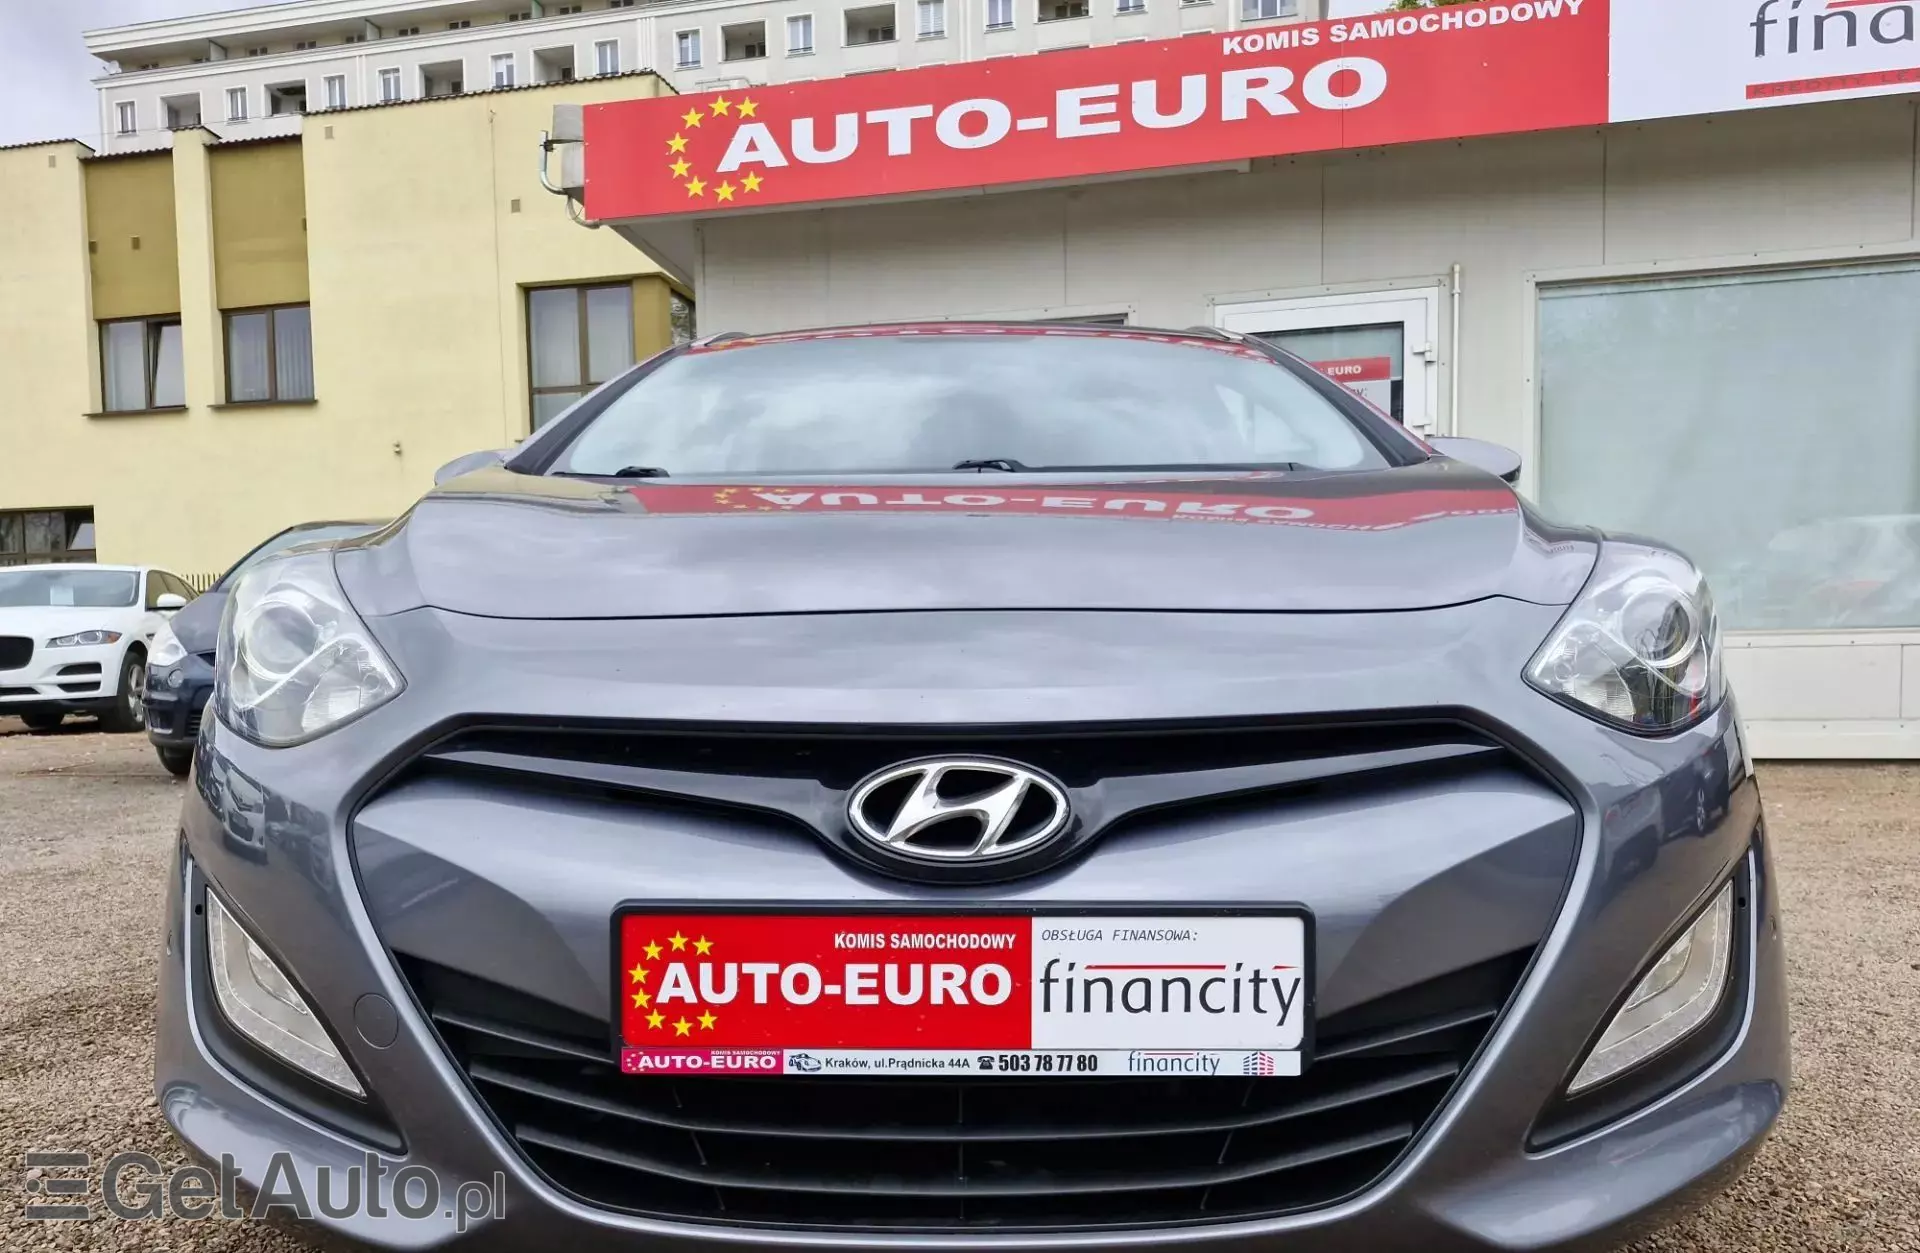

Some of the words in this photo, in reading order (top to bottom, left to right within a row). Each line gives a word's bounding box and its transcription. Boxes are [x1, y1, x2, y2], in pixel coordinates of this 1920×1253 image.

[1222, 27, 1320, 56] KOMIS
[1329, 0, 1585, 44] SAMOCHODOWY
[715, 56, 1389, 174] AUTO-EURO
[834, 933, 886, 949] KOMIS
[890, 933, 1017, 950] SAMOCHODOWY
[1041, 929, 1104, 941] OBSŁUGA
[1112, 929, 1199, 942] FINANSOWA:
[655, 962, 1013, 1006] AUTO-EURO
[1039, 958, 1302, 1027] financity
[638, 1055, 777, 1069] AUTO-EURO
[825, 1057, 872, 1071] Kraków,
[874, 1057, 945, 1071] ul.Prądnicka
[948, 1058, 970, 1069] 44A
[998, 1054, 1031, 1072] 503
[1034, 1054, 1053, 1072] 78
[1056, 1054, 1073, 1072] 77
[1077, 1054, 1098, 1072] 80
[1127, 1050, 1221, 1075] financity
